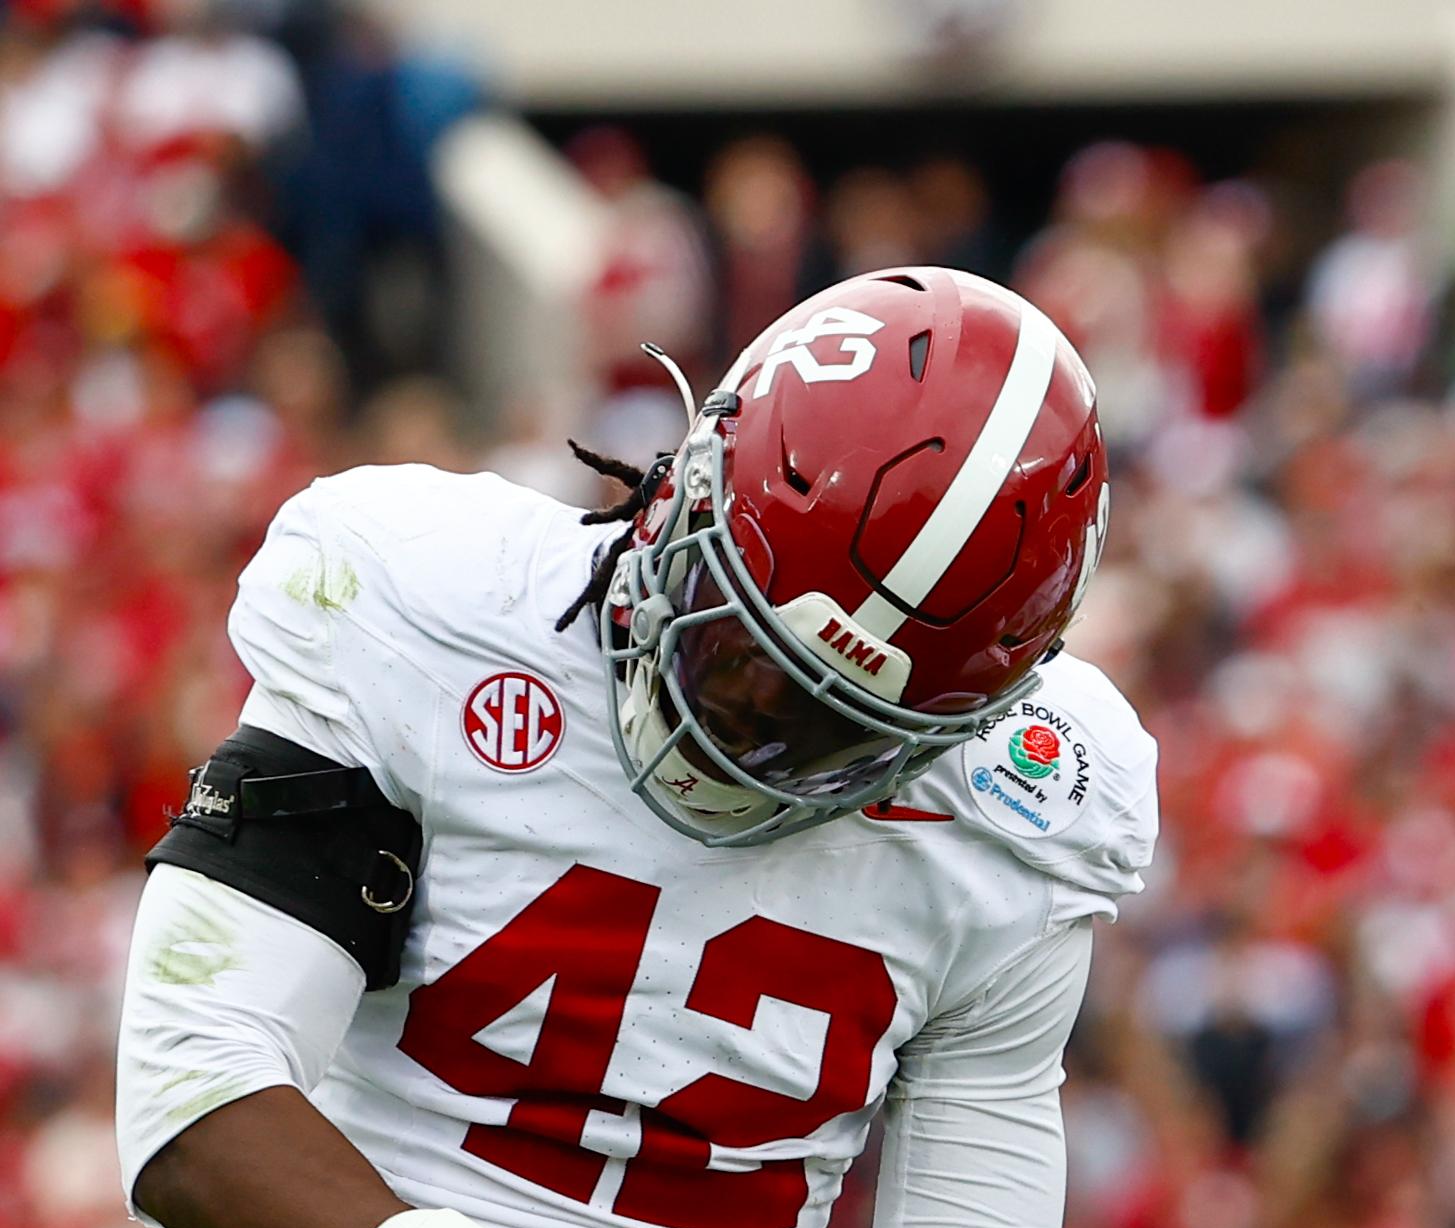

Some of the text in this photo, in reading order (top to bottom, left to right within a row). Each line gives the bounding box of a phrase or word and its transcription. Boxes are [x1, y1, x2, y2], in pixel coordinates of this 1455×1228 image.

[753, 306, 885, 399] 42
[817, 616, 889, 677] BAMA
[470, 676, 556, 766] SEC
[661, 773, 699, 795] A
[994, 764, 1048, 804] presented by
[1021, 702, 1072, 742] BOWL
[1067, 743, 1090, 806] GAME
[990, 783, 1052, 833] Prudential
